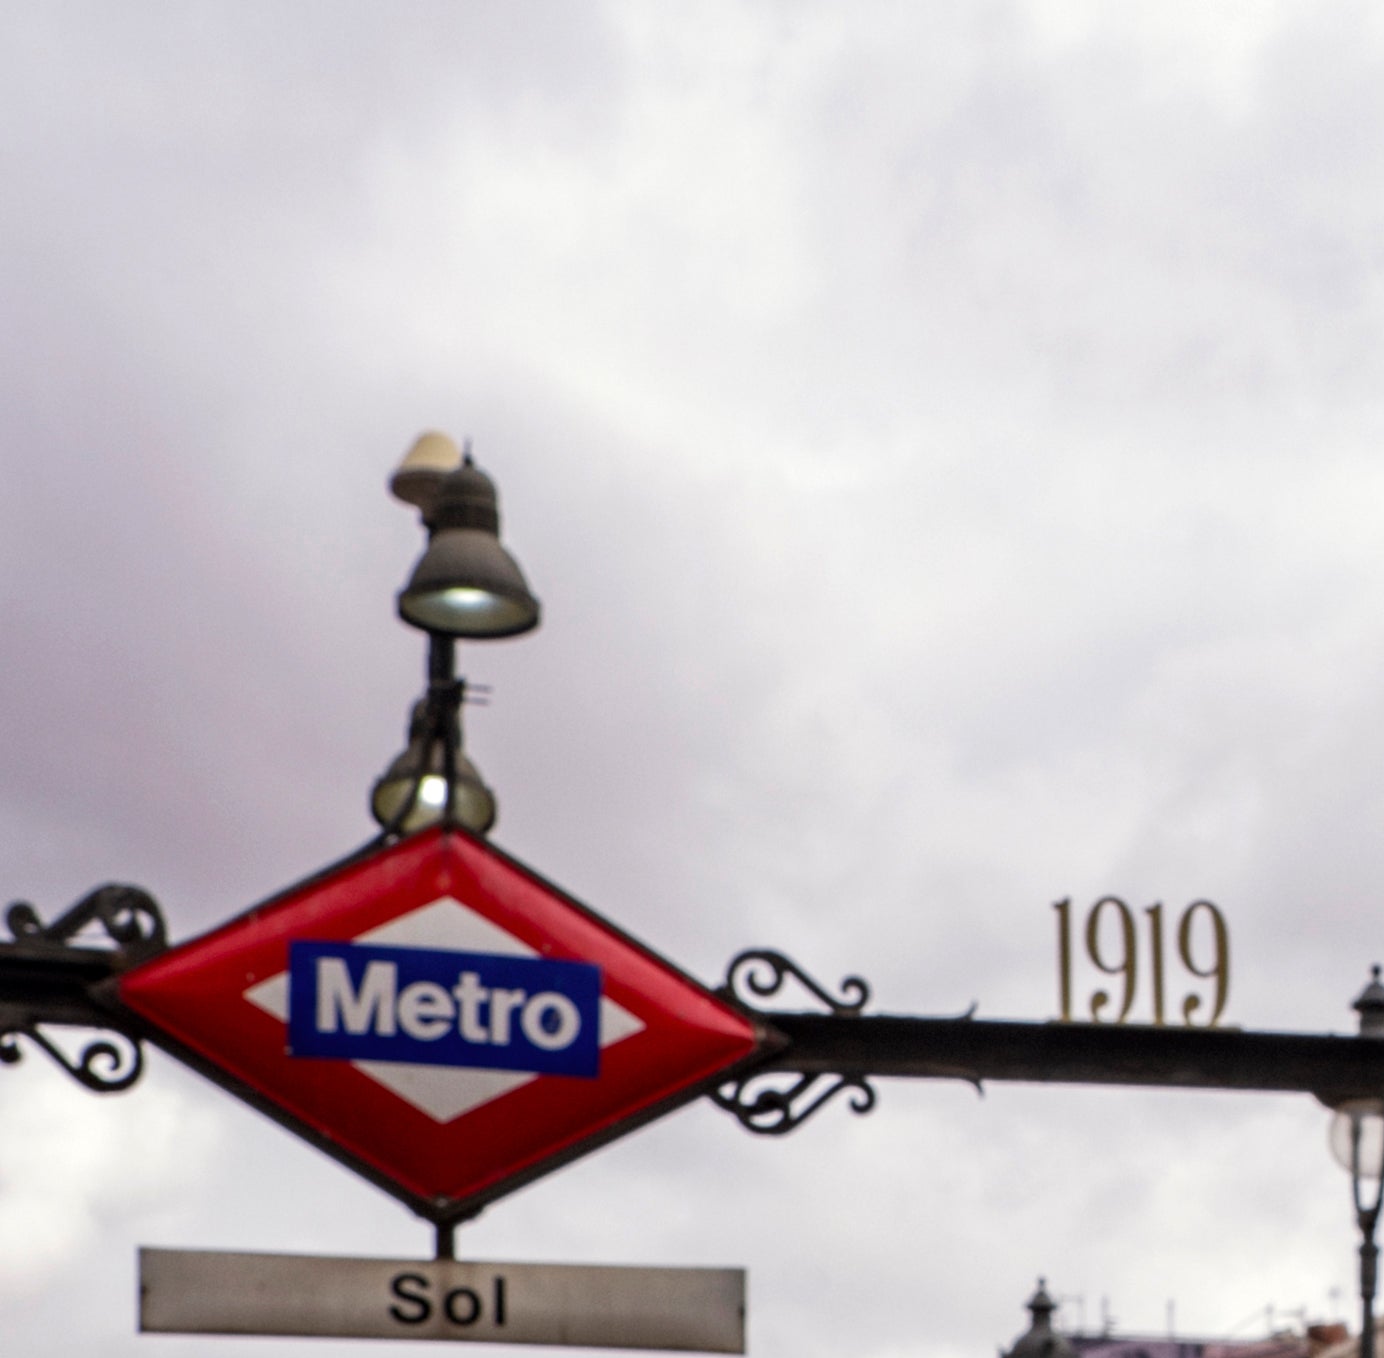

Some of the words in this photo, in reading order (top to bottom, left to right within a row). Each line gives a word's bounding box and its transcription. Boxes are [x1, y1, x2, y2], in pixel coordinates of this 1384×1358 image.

[314, 956, 582, 1052] Metro
[1052, 895, 1231, 1027] 1919
[387, 1273, 508, 1330] Sol
